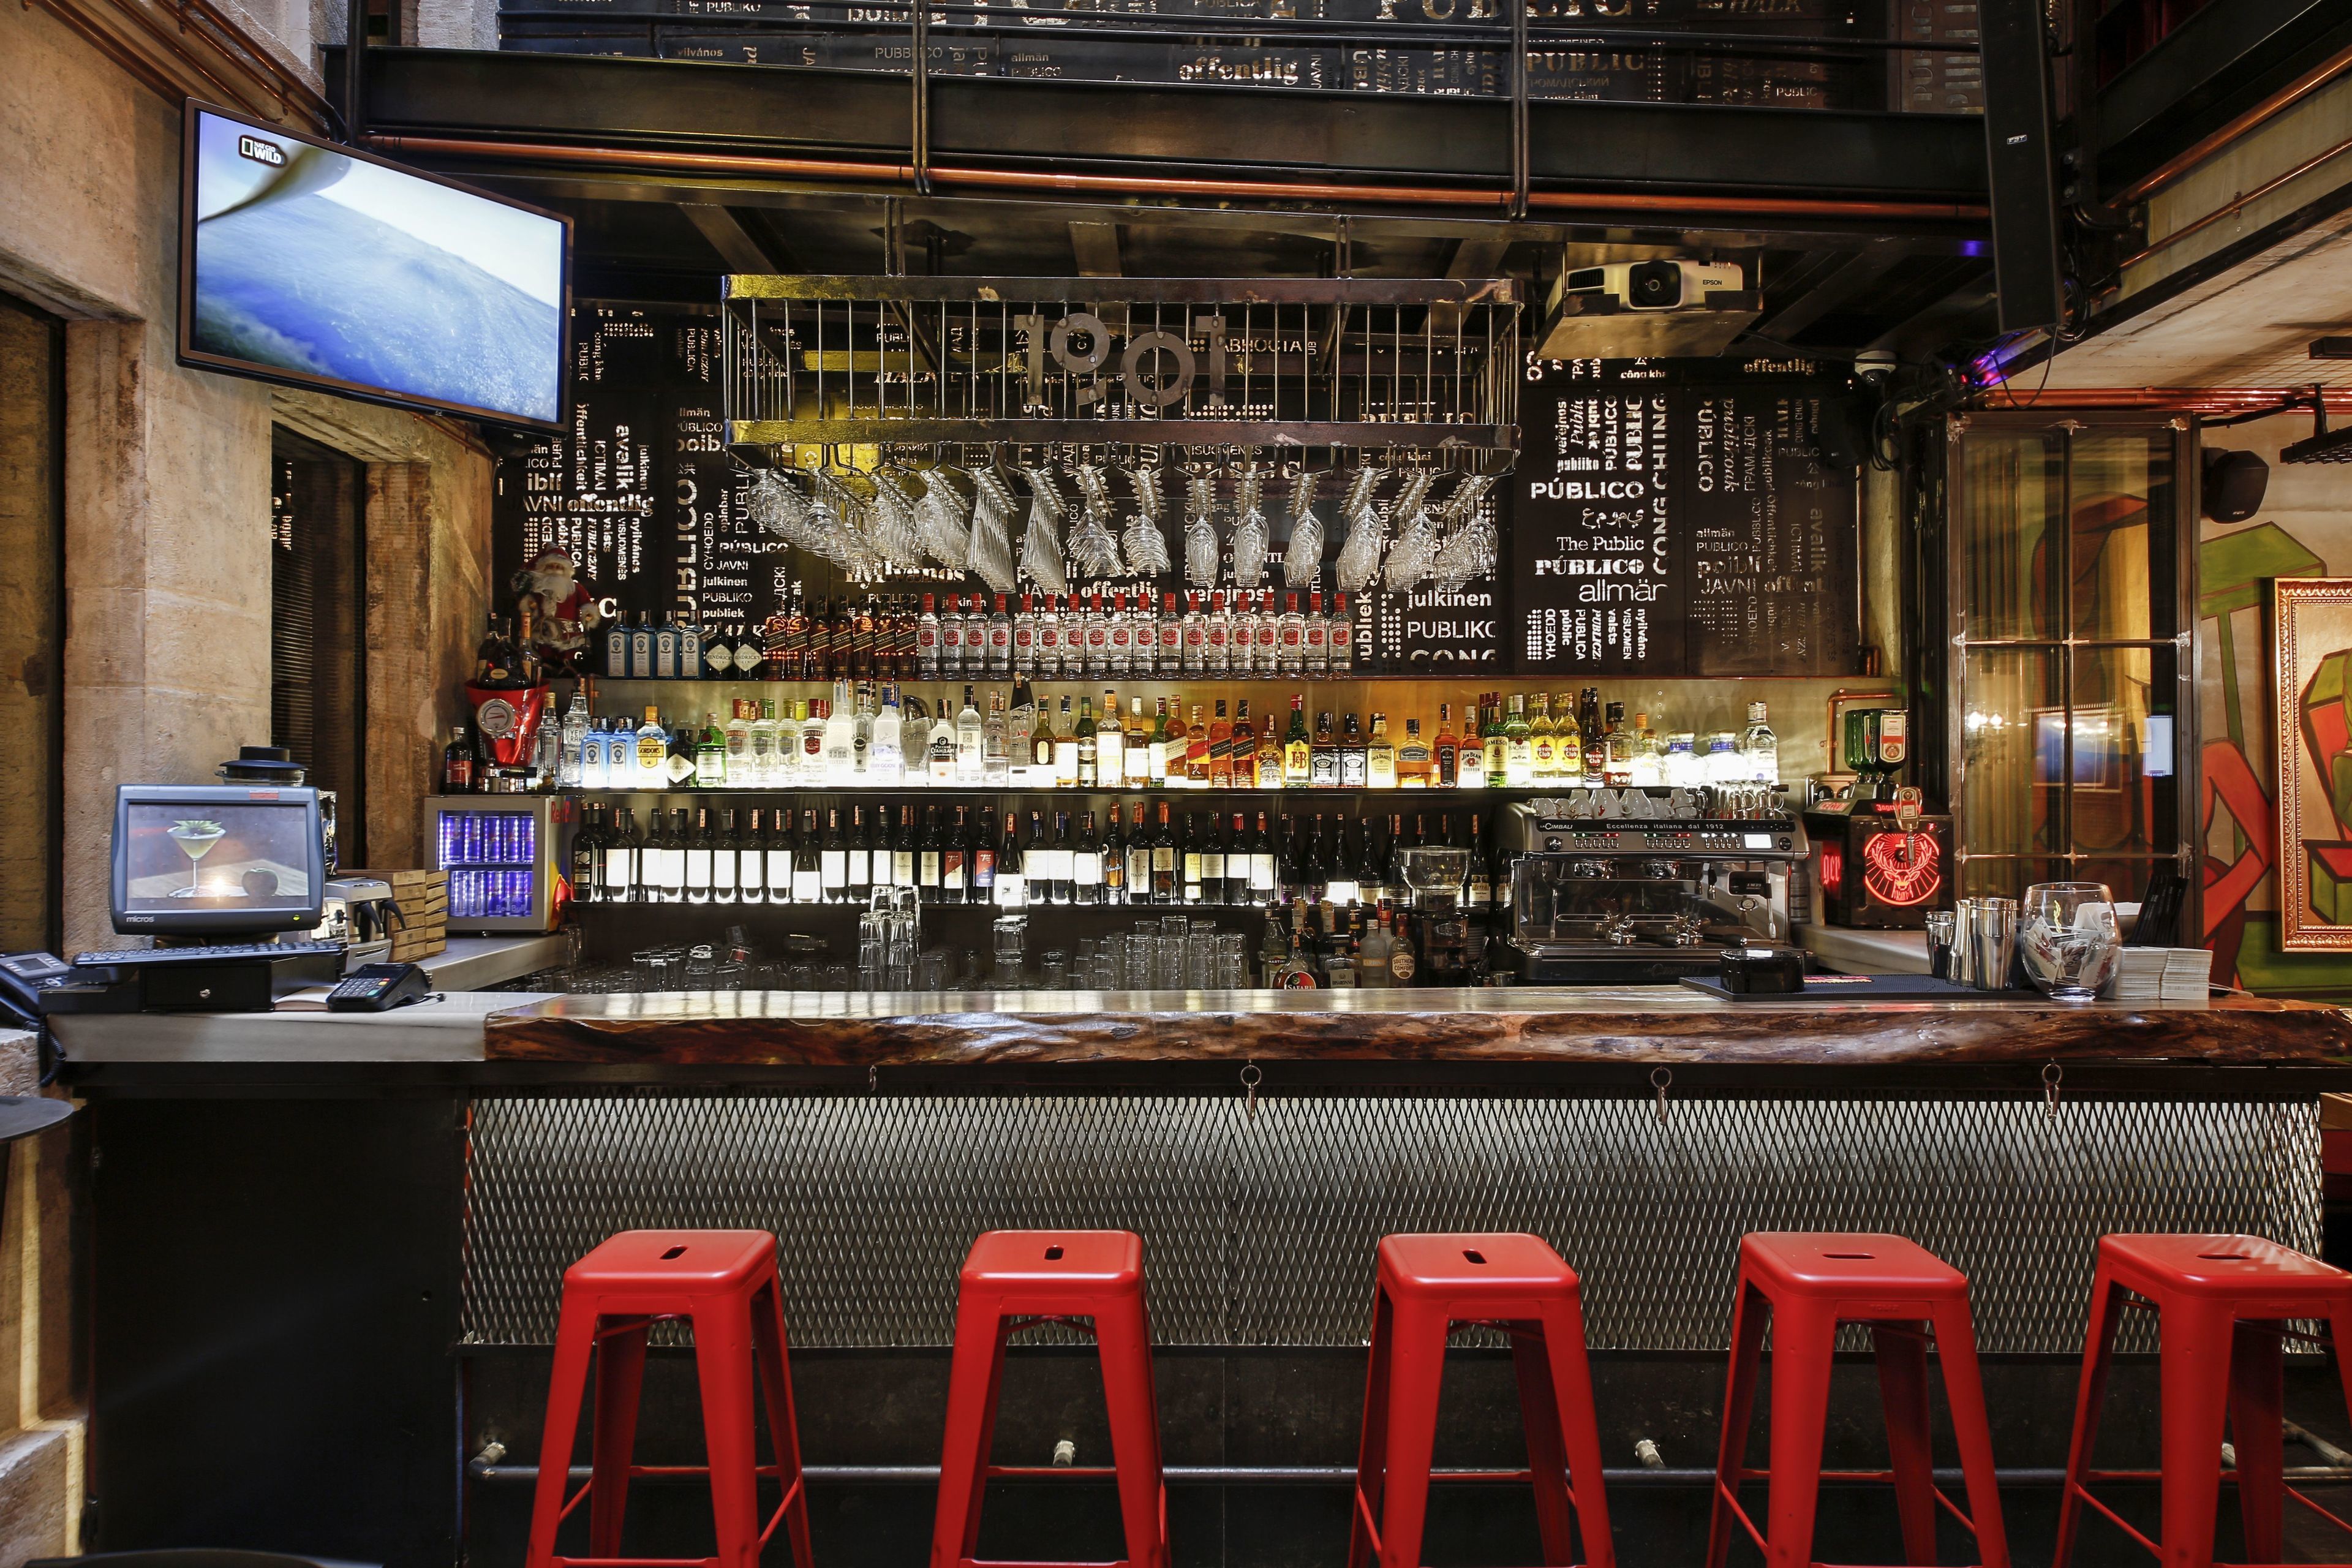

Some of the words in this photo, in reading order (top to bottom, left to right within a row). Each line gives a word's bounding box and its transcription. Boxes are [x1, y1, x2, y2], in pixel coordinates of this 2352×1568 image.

[254, 146, 282, 164] WILD
[1744, 358, 1815, 375] offentlig
[616, 424, 634, 490] avalik
[1531, 477, 1644, 500] PÚBLICO
[704, 513, 714, 570] CYHOEDD
[1696, 527, 1735, 537] allmän
[571, 518, 582, 568] PUBLICA
[1556, 536, 1588, 551] The
[1593, 535, 1645, 551] Public
[716, 560, 748, 570] JAVNI
[1534, 556, 1645, 576] PÚBLICO
[703, 576, 747, 588] julkinen
[1700, 578, 1757, 595] JAVNI
[703, 592, 753, 603] PUBLIKO
[1408, 589, 1492, 611] julkinen
[703, 608, 745, 619] publiek
[1559, 609, 1572, 646] públic
[1575, 609, 1586, 660] PUBLICA
[1608, 609, 1618, 645] valsts
